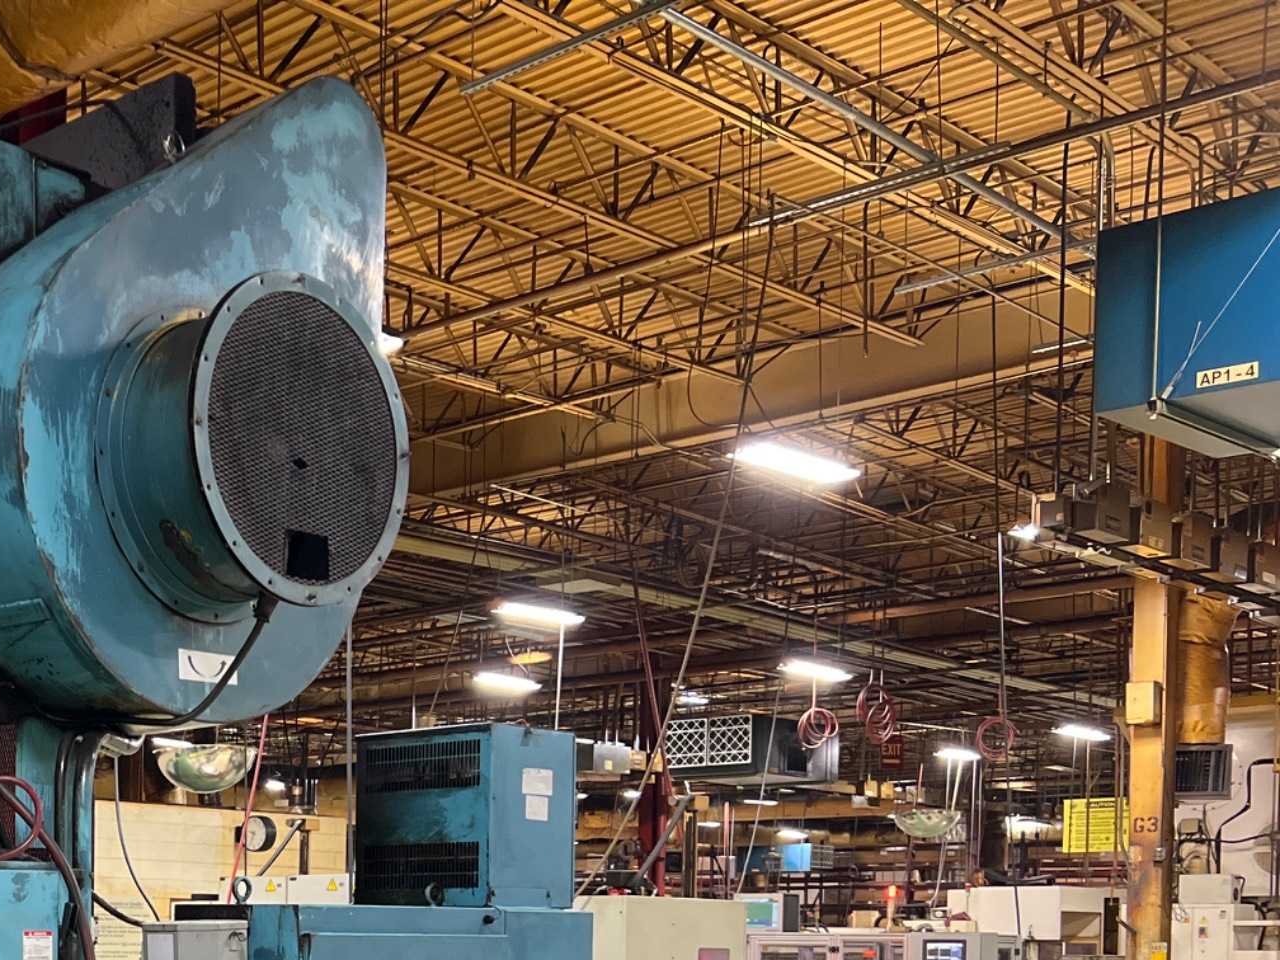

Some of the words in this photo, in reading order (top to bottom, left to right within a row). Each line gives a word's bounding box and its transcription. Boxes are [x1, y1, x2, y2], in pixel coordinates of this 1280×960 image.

[1200, 368, 1230, 386] AP1
[881, 743, 902, 755] EXIT
[1134, 816, 1158, 833] G3
